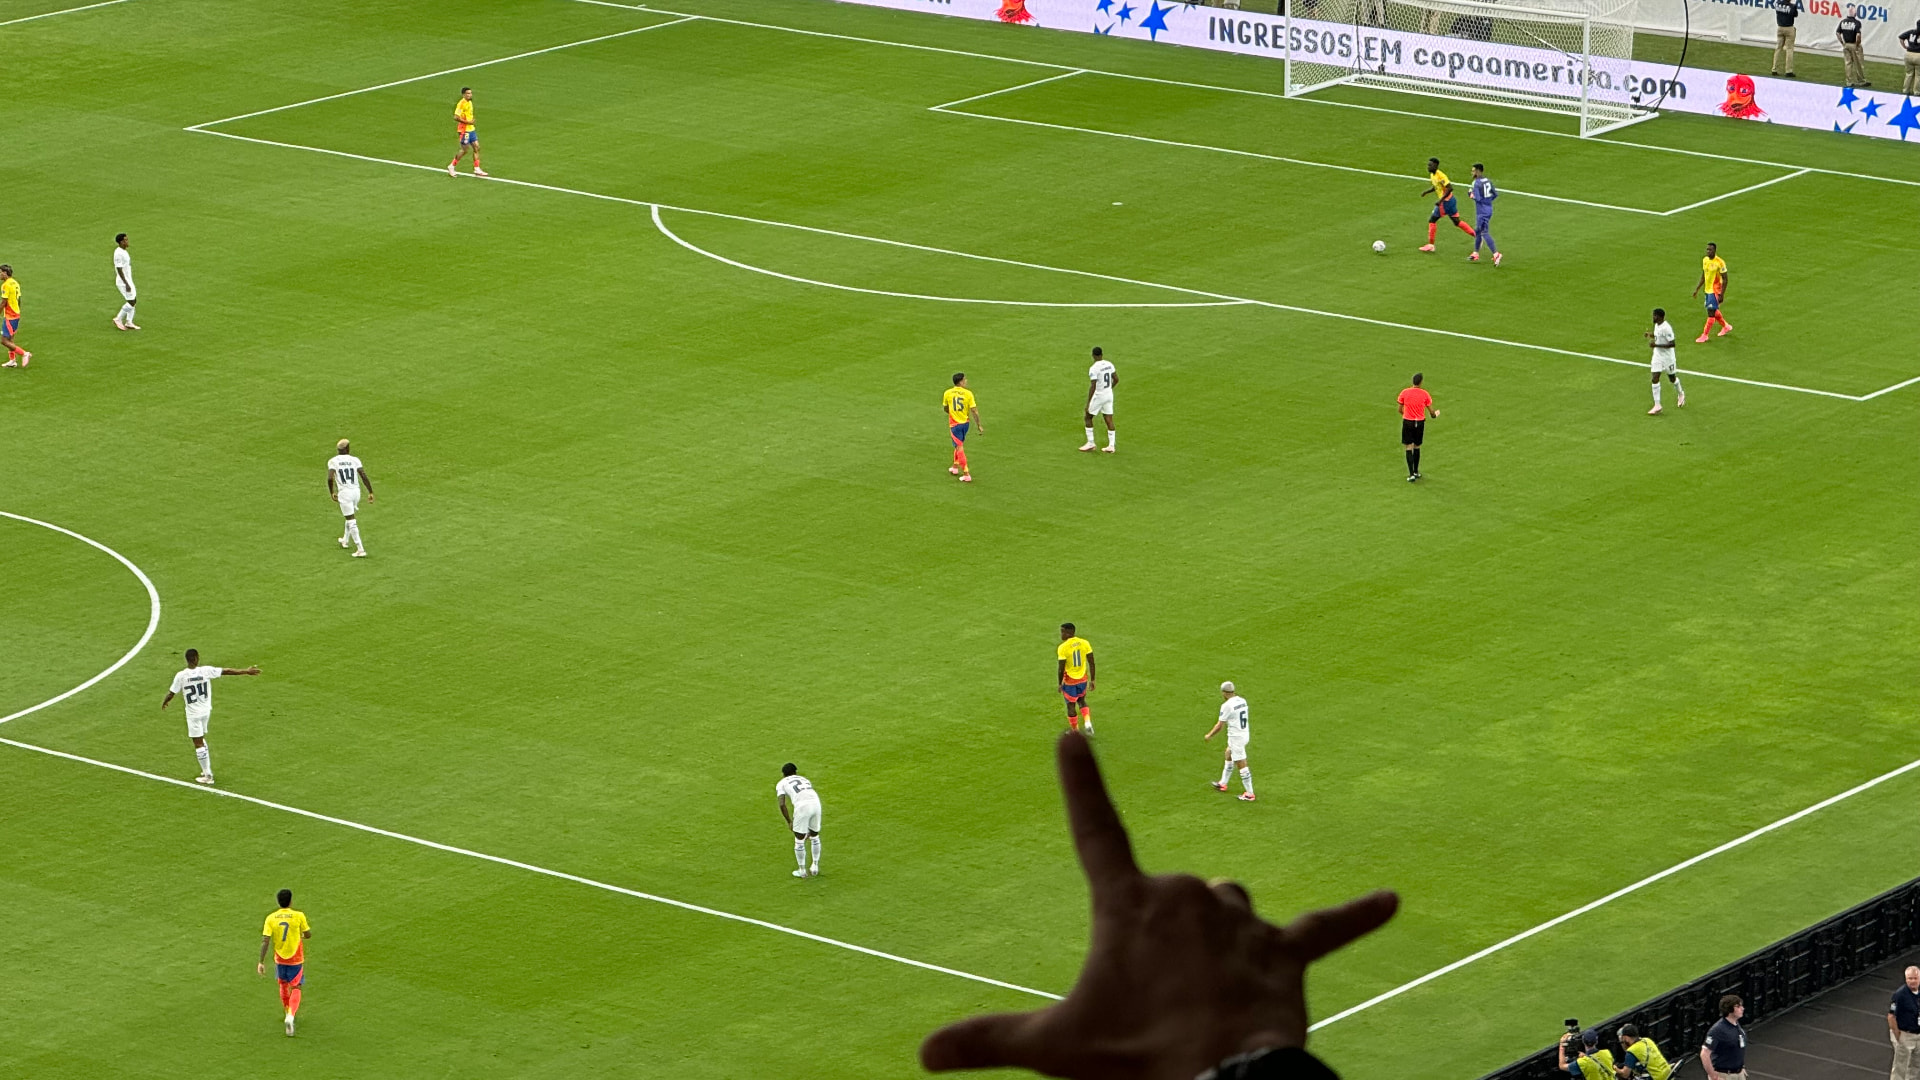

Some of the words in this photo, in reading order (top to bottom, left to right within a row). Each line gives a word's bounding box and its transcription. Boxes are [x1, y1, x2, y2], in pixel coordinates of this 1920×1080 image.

[1809, 0, 1842, 18] USA
[1209, 16, 1352, 58] INGRESSOS
[1364, 36, 1402, 65] EM
[1483, 182, 1492, 198] 12
[1103, 372, 1110, 389] 9
[952, 396, 965, 412] 15
[338, 467, 355, 485] 14
[1072, 649, 1082, 668] 11
[183, 681, 208, 705] 24
[1239, 710, 1248, 730] 6
[279, 921, 290, 942] 7
